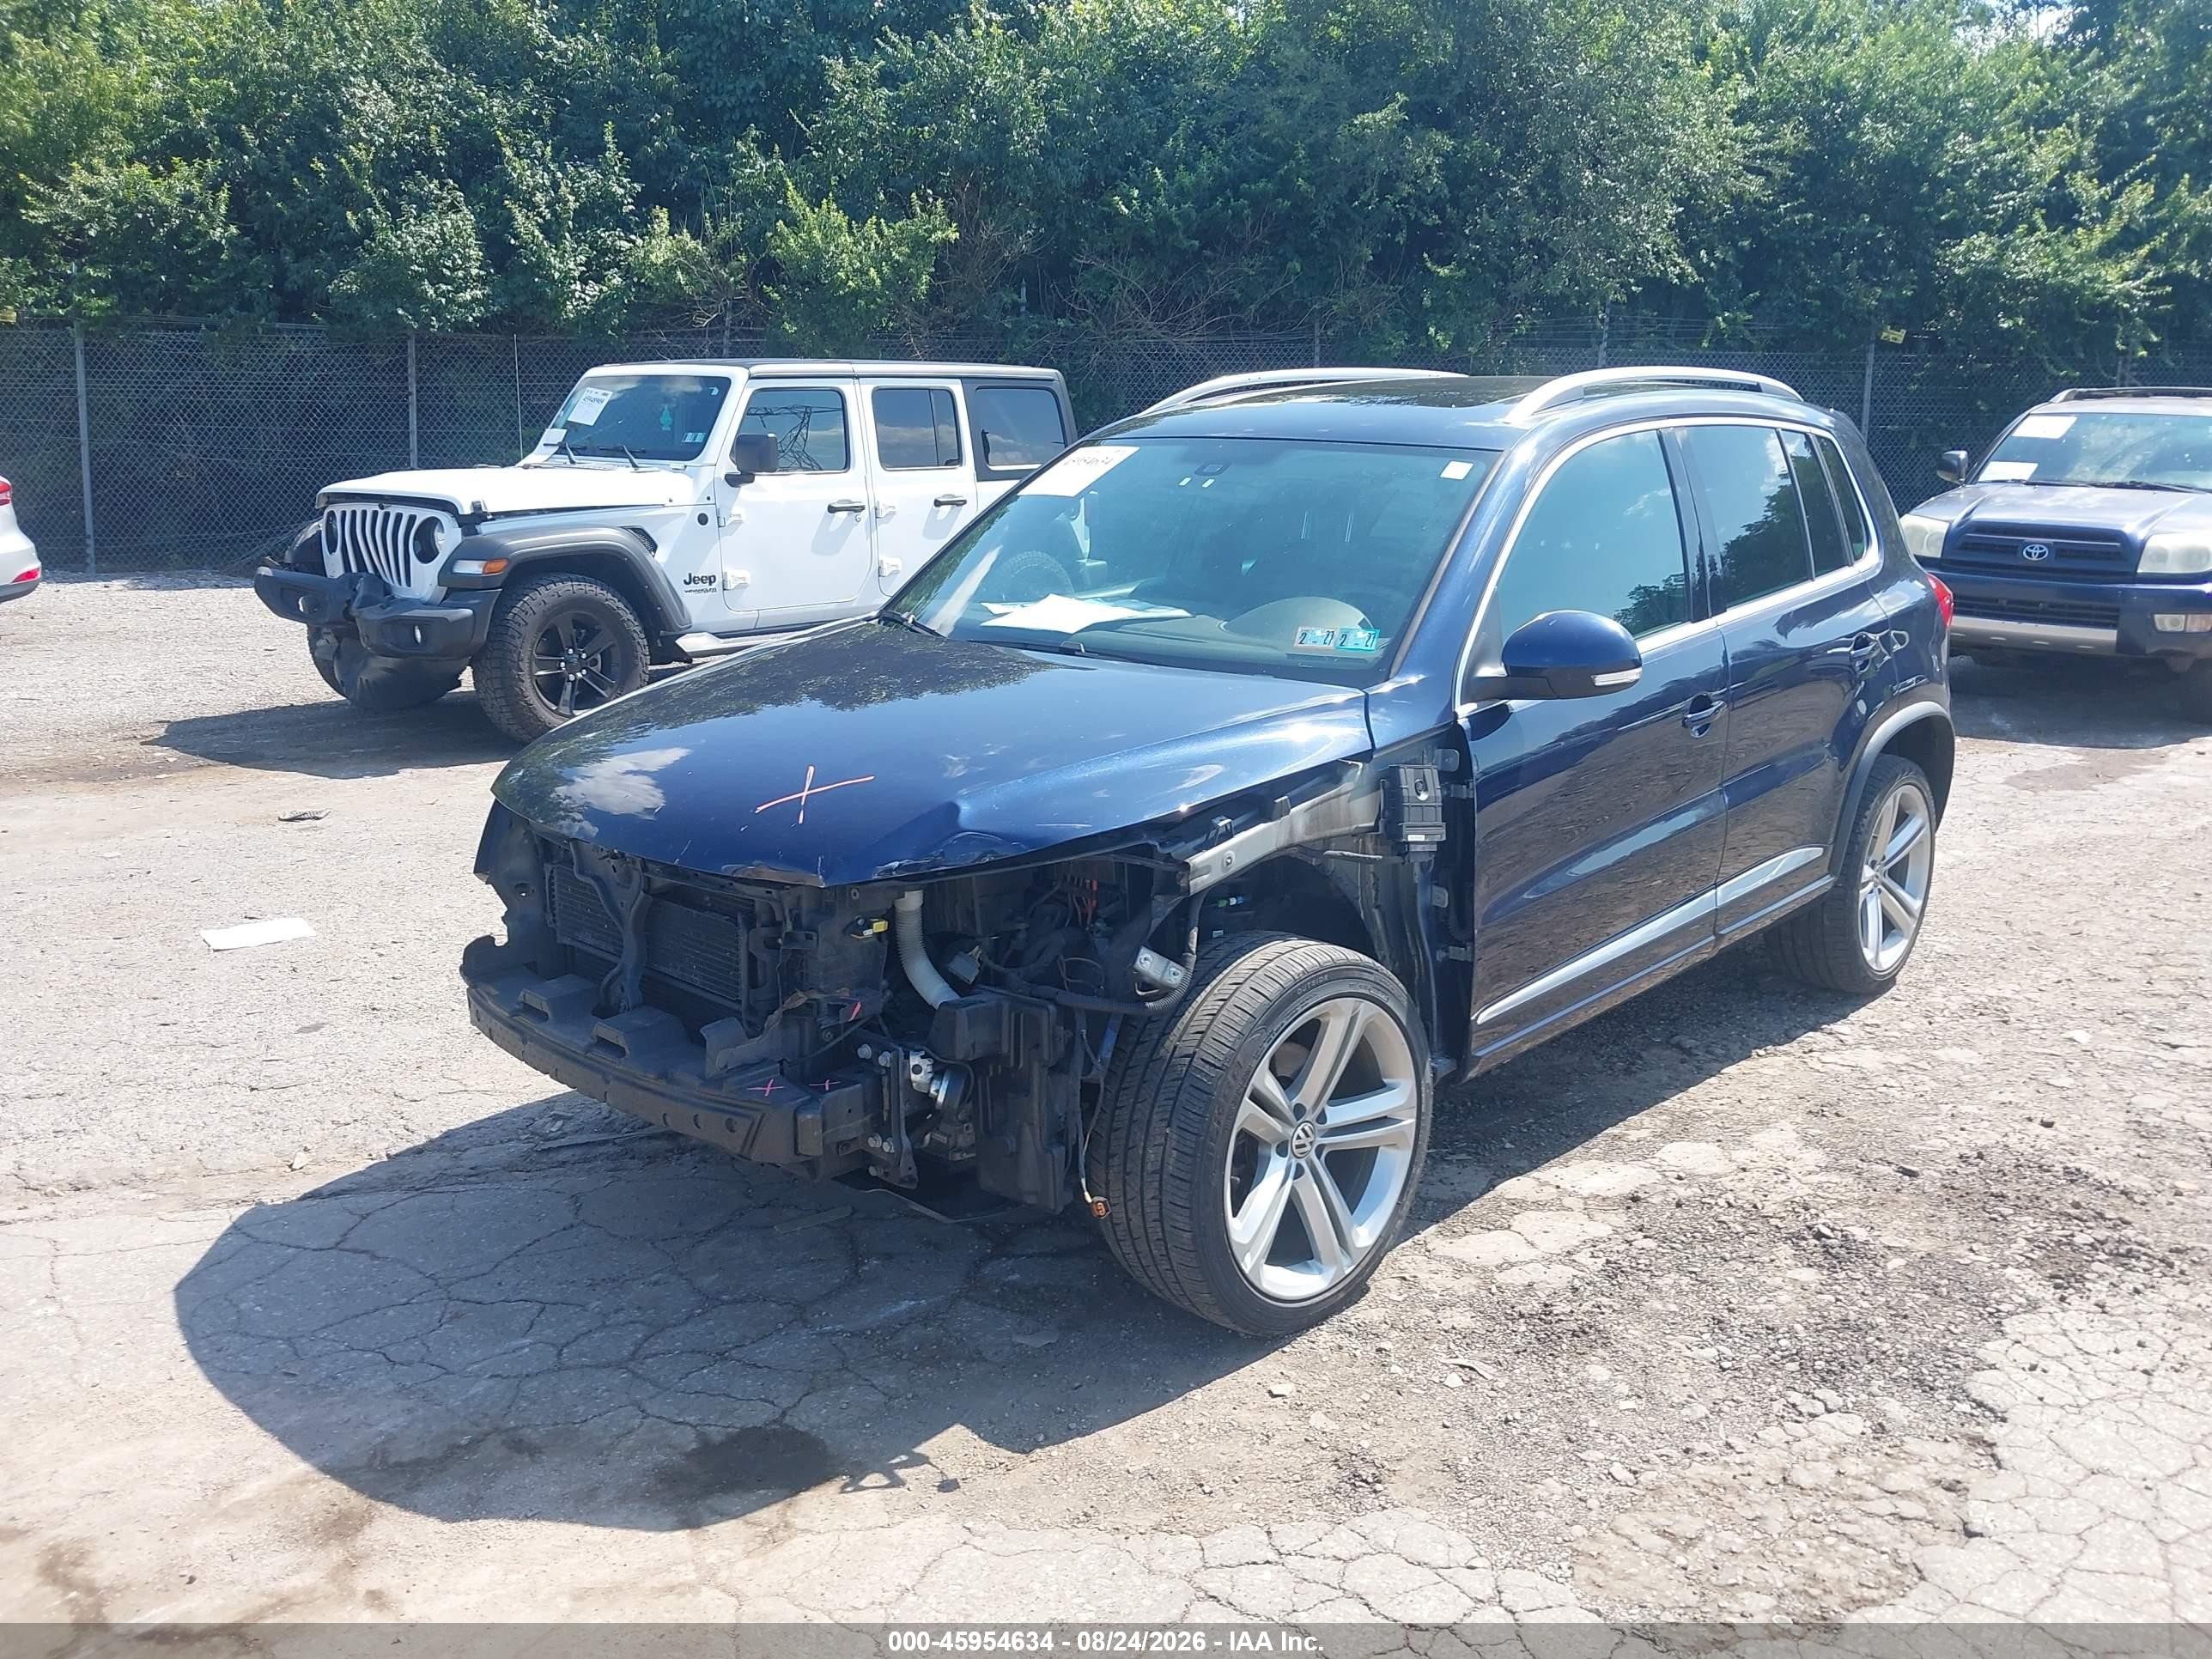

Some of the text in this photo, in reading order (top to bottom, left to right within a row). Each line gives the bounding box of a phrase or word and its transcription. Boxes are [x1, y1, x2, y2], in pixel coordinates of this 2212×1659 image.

[683, 572, 717, 586] Jeep
[1298, 632, 1308, 645] 2
[1340, 634, 1347, 647] 2
